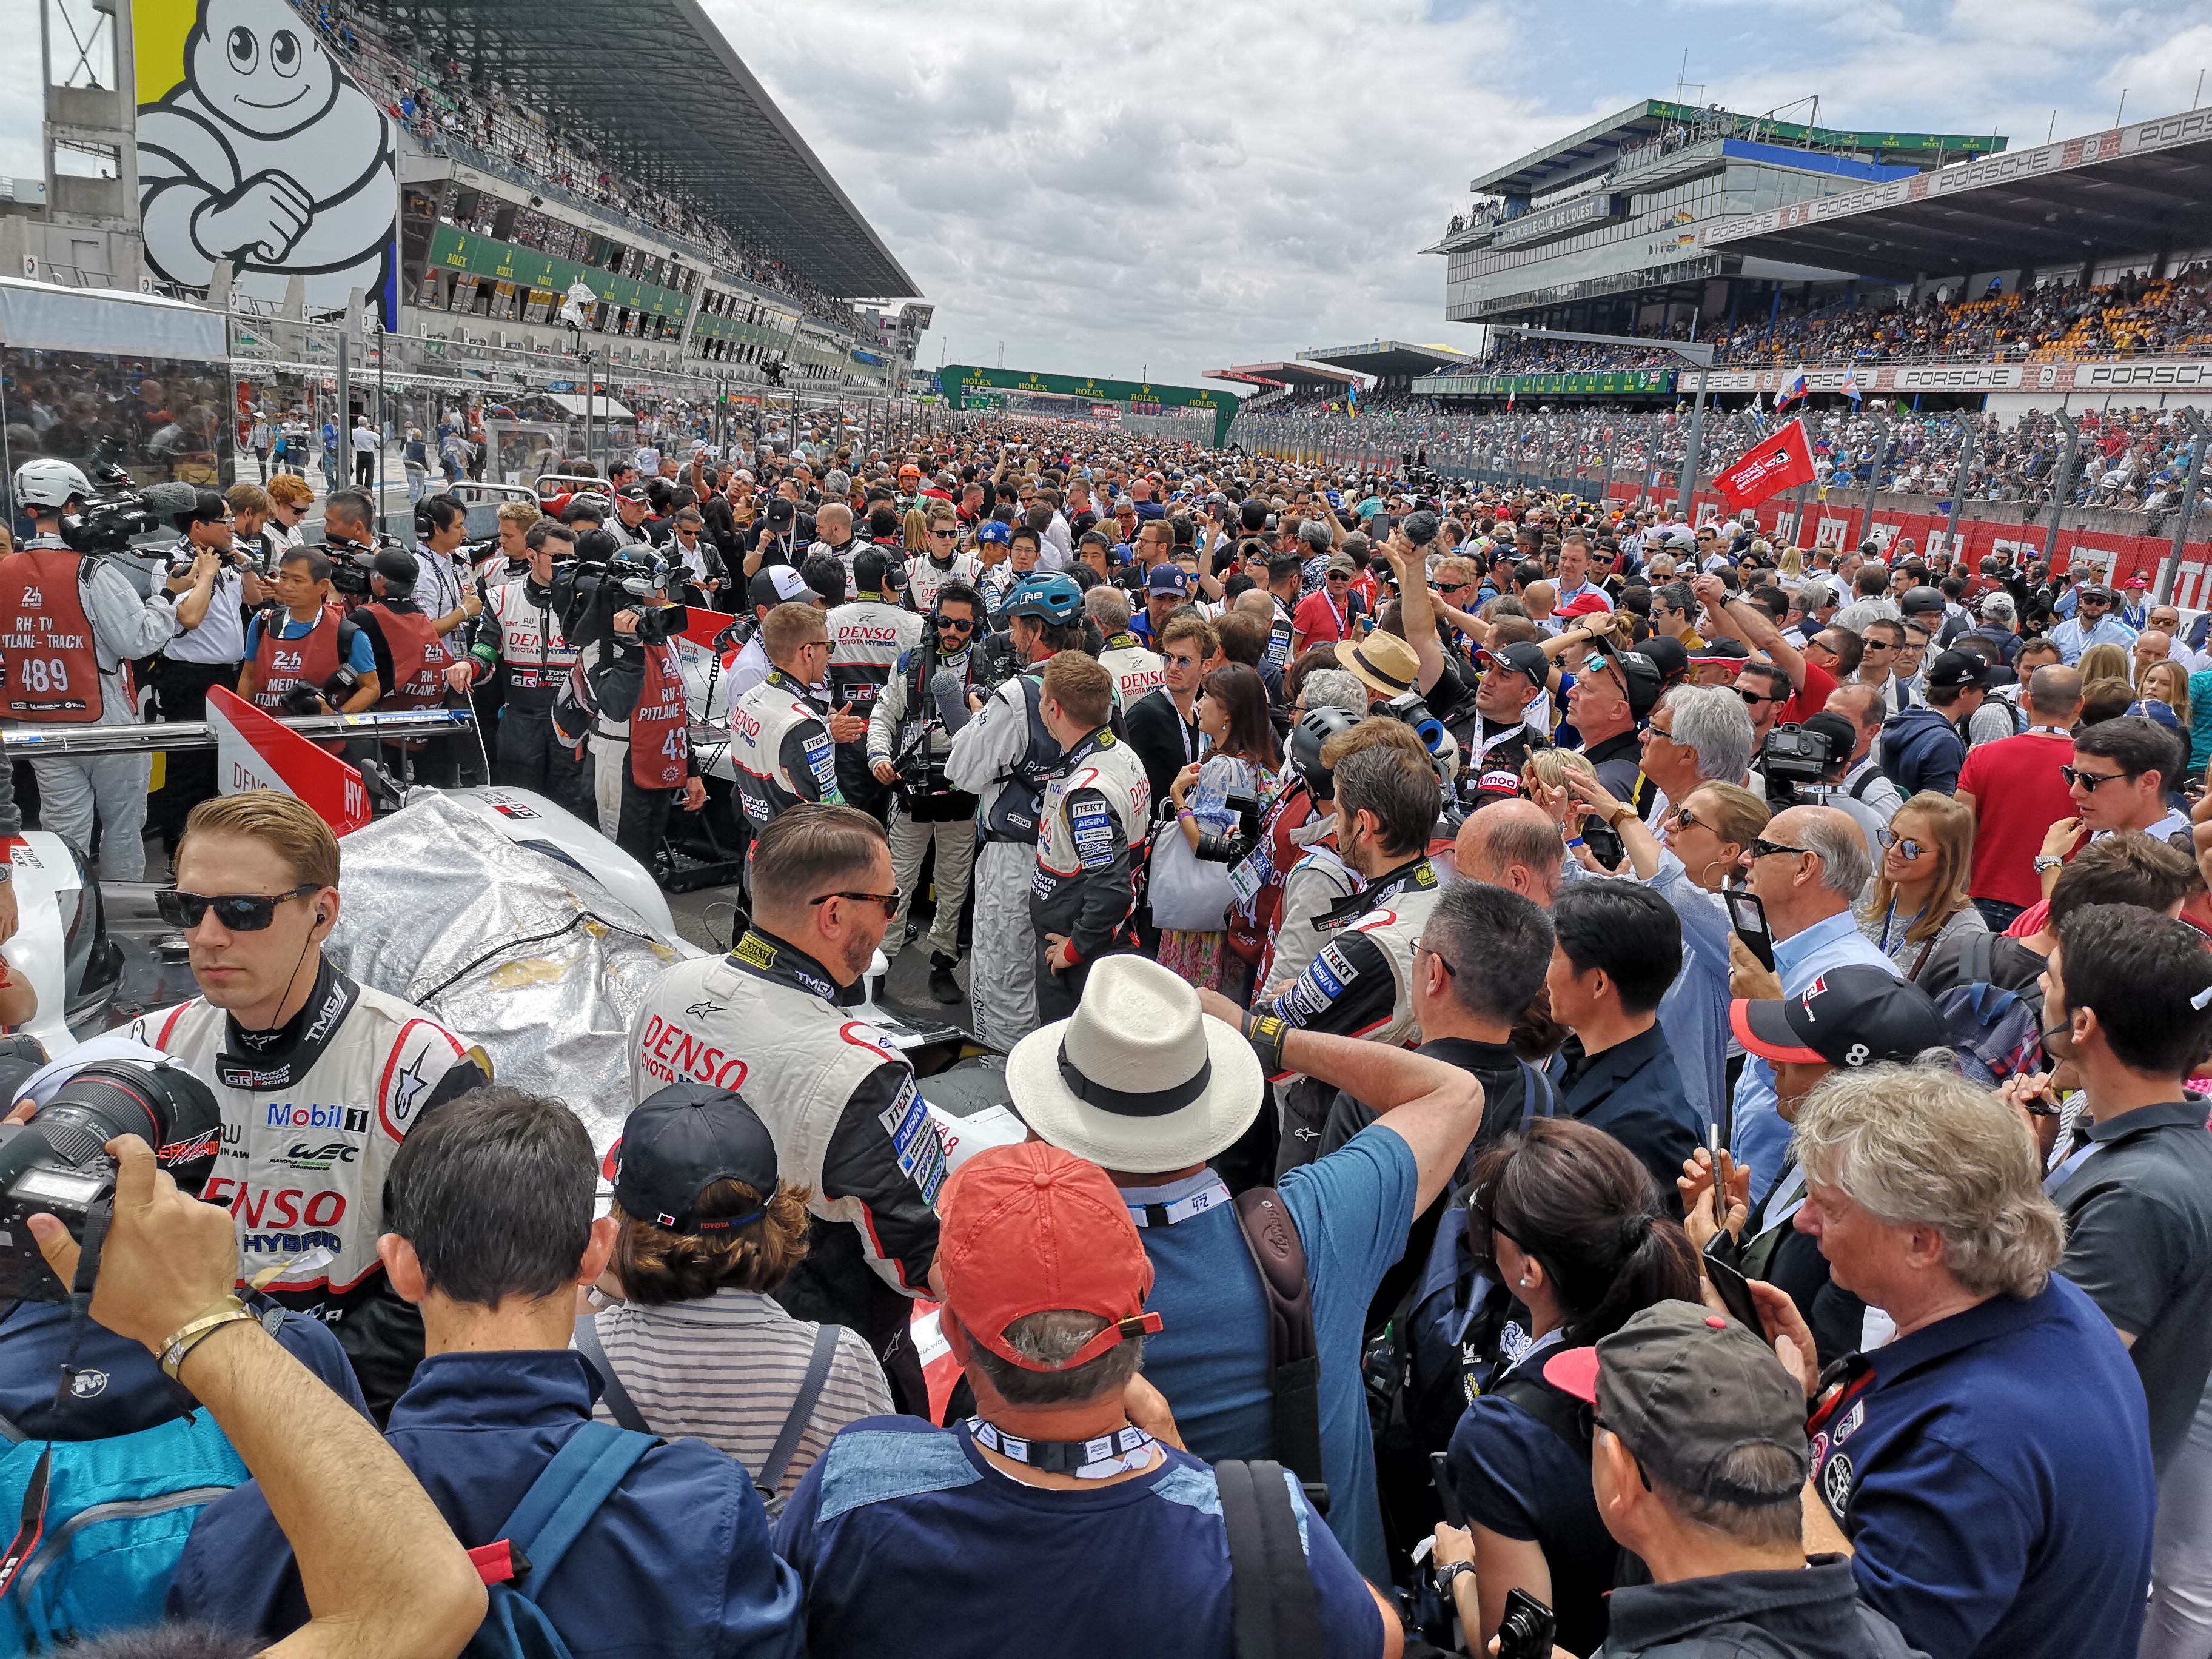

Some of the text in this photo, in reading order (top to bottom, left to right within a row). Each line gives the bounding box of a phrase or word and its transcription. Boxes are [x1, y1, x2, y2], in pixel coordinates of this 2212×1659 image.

[1940, 152, 2051, 190] PORSCHE
[1817, 186, 1899, 216] PORSCHE
[1501, 202, 1594, 243] AUTOMOBILE CLUB DE L'OUEST
[1712, 214, 1774, 240] PORSCHE
[447, 253, 467, 268] ROLEX
[496, 264, 514, 278] ROLEX
[537, 275, 552, 287] ROLEX
[324, 380, 336, 389] 54
[962, 377, 991, 386] ROLEX
[1905, 371, 2009, 386] PORSCHE
[449, 387, 460, 396] 52
[1018, 382, 1048, 392] ROLEX
[1074, 387, 1104, 397] ROLEX
[1131, 393, 1160, 403] ROLEX
[1189, 399, 1218, 408] ROLEX
[1093, 407, 1119, 417] MOTUL
[16, 616, 53, 631] RH TV
[838, 626, 896, 640] DENSO
[47, 634, 84, 649] TRACK
[273, 651, 302, 666] 24h
[21, 658, 69, 692] 489
[421, 669, 433, 683] RH
[512, 674, 537, 687] GR
[662, 686, 676, 702] RH
[844, 689, 873, 699] GR
[1122, 688, 1145, 697] TOYOTA
[638, 702, 679, 722] PITLANE
[731, 706, 760, 737] DENSO
[806, 734, 827, 750] JTEKT
[1070, 743, 1091, 766] TMG
[1480, 775, 1516, 788] kimoa
[345, 777, 363, 819] HY
[504, 804, 540, 818] GR
[1075, 803, 1104, 816] JTEKT
[1009, 815, 1030, 826] MOTUL
[1077, 816, 1105, 828] AISIN
[21, 848, 45, 869] TOYOTA
[1373, 882, 1399, 905] TMG
[1324, 946, 1353, 979] JTEKT
[1312, 960, 1338, 993] AISIN
[304, 990, 342, 1042] TMG
[643, 1013, 748, 1092] DENSO
[1845, 1043, 1869, 1066] 8
[253, 1064, 290, 1076] TOYOTA
[253, 1070, 289, 1081] GAZOO
[226, 1073, 252, 1086] GR
[887, 1081, 913, 1131] JTEKT
[267, 1103, 343, 1128] Mobil
[900, 1101, 925, 1149] AISIN
[232, 1150, 249, 1159] AW
[287, 1143, 361, 1162] WEC
[197, 1178, 347, 1228] ENSO
[244, 1230, 341, 1254] HYBRID
[919, 1347, 931, 1356] FIA
